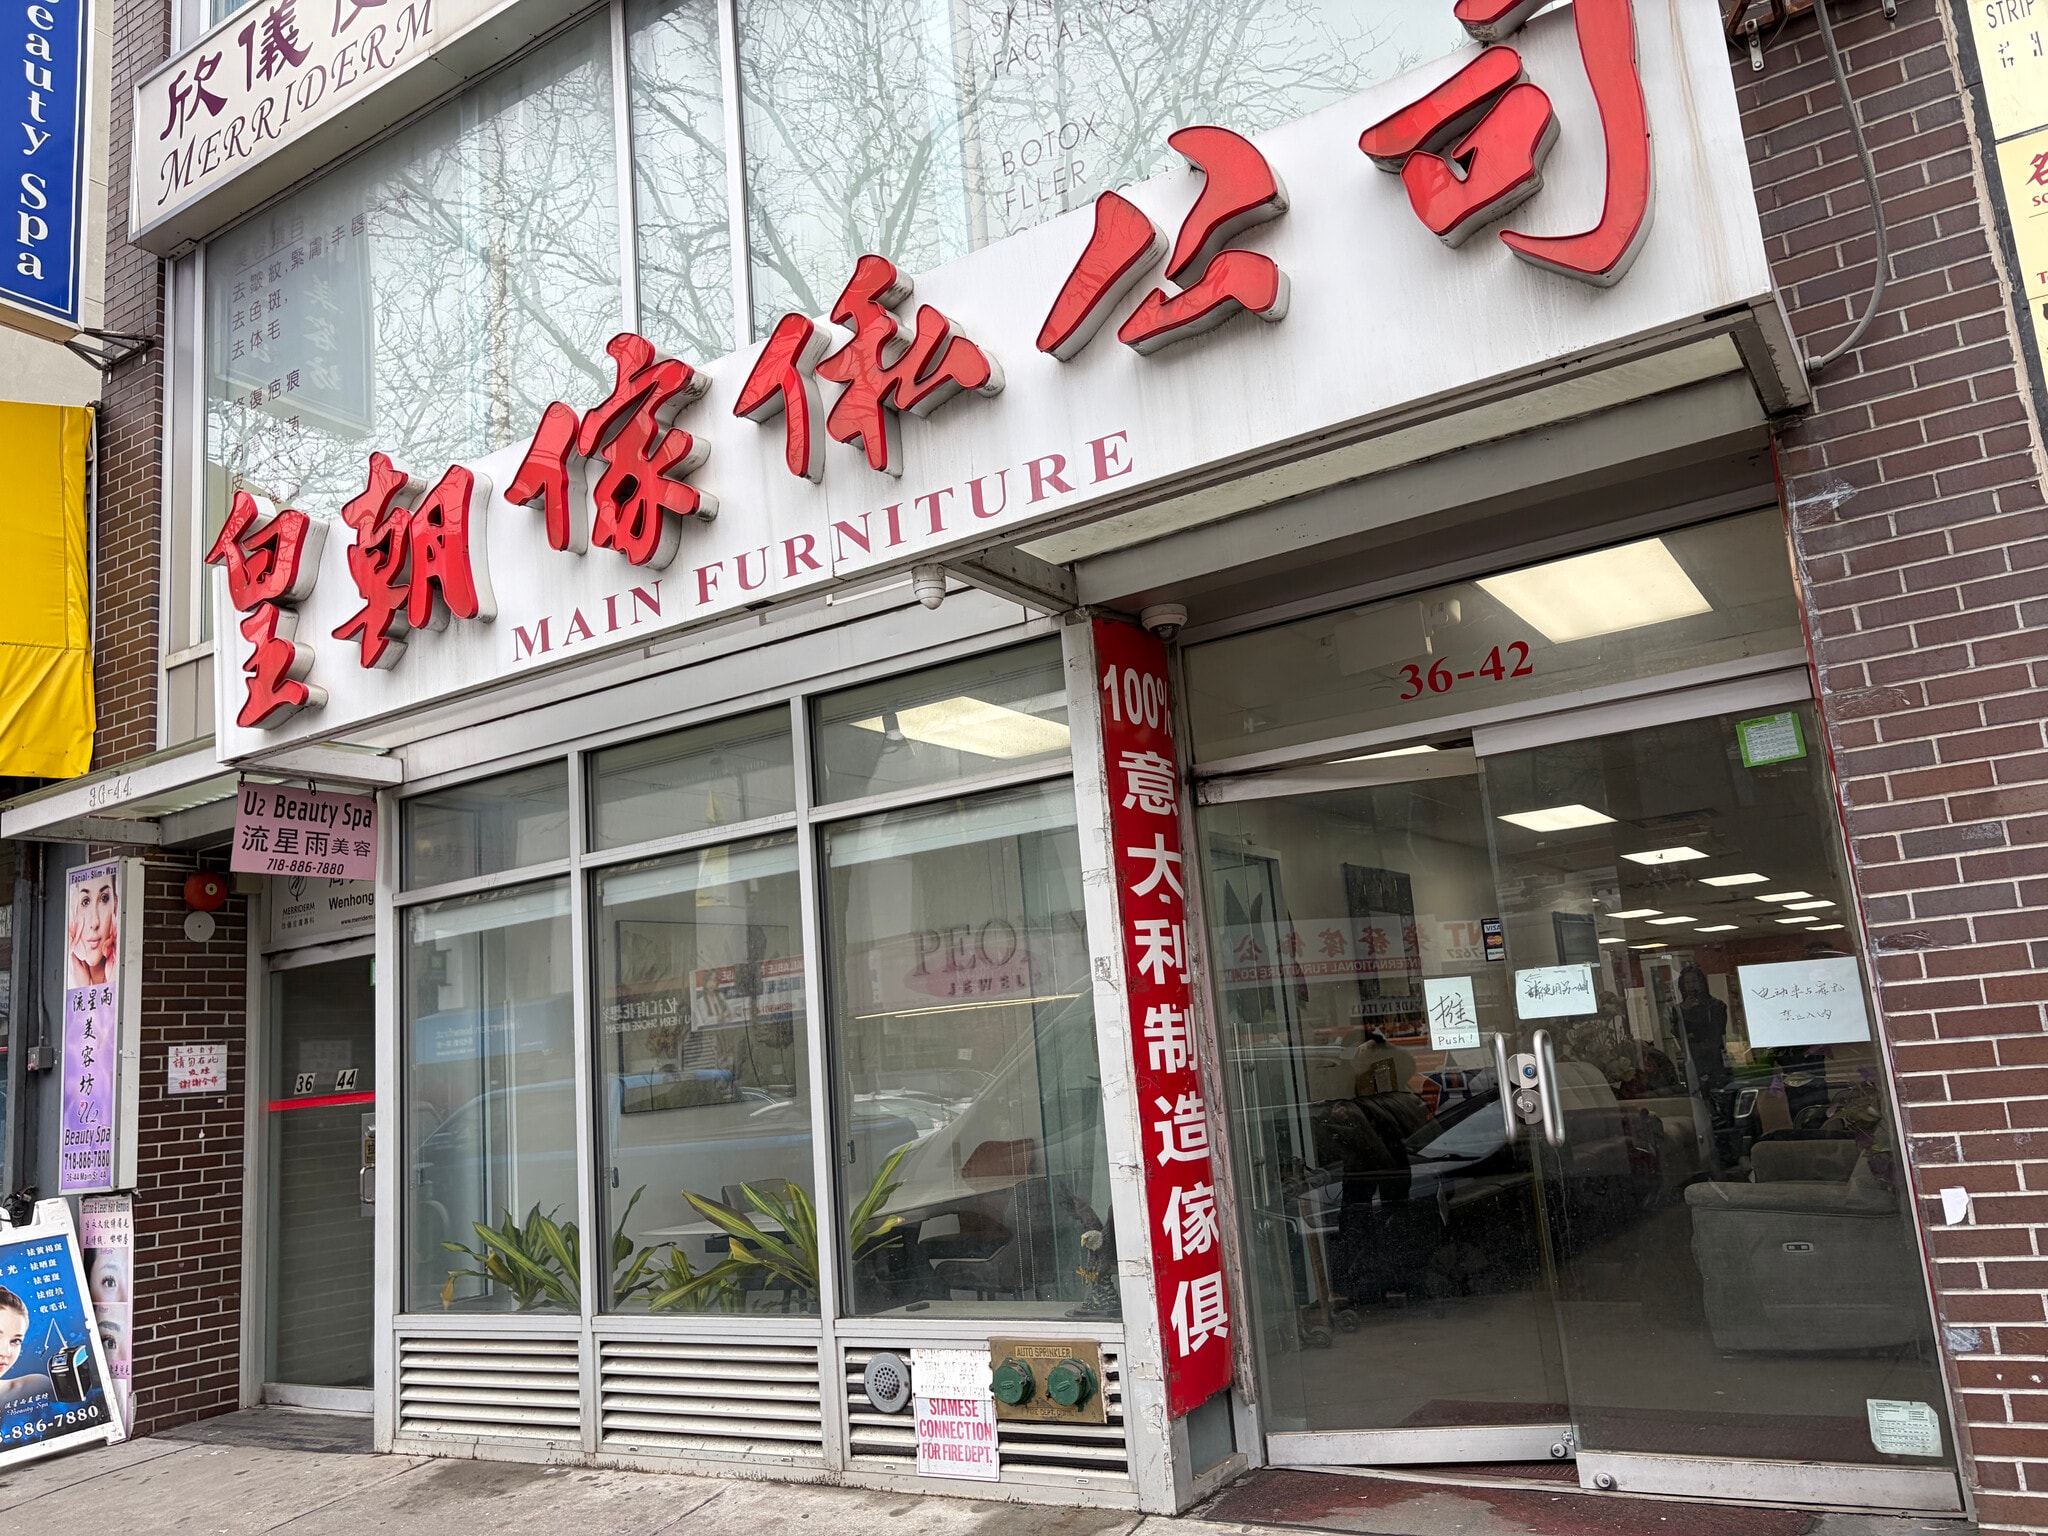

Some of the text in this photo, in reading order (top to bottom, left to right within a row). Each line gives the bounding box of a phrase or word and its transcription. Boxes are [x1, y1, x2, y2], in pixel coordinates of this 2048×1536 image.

[992, 13, 1089, 79] FACIAL
[157, 0, 433, 206] MERRIDERM
[17, 0, 56, 280] eauty Spa
[1002, 111, 1098, 177] BOTOX
[512, 429, 1135, 663] MAIN FURNITURE
[1398, 640, 1534, 700] 36-42
[1102, 663, 1174, 739] 100%
[88, 776, 132, 808] 36-44
[243, 790, 373, 832] U2 Beauty Spa
[241, 824, 371, 858] 流星雨美容
[71, 872, 88, 884] Facial
[266, 858, 345, 876] 718-886-7880
[282, 901, 315, 916] MERRIDERM
[328, 892, 375, 911] Wenhong
[340, 913, 376, 925] www.merriderm.
[1486, 924, 1501, 932] VISA
[296, 1070, 356, 1093] 36 44
[64, 1125, 111, 1147] Beauty Spa
[1016, 1346, 1071, 1358] AUTO SPRINKLER
[929, 1398, 979, 1418] SIAMESE
[0, 1404, 99, 1443] -886-7880
[919, 1419, 993, 1441] CONNECTION
[922, 1442, 993, 1464] FOR FIRE DEPT.
